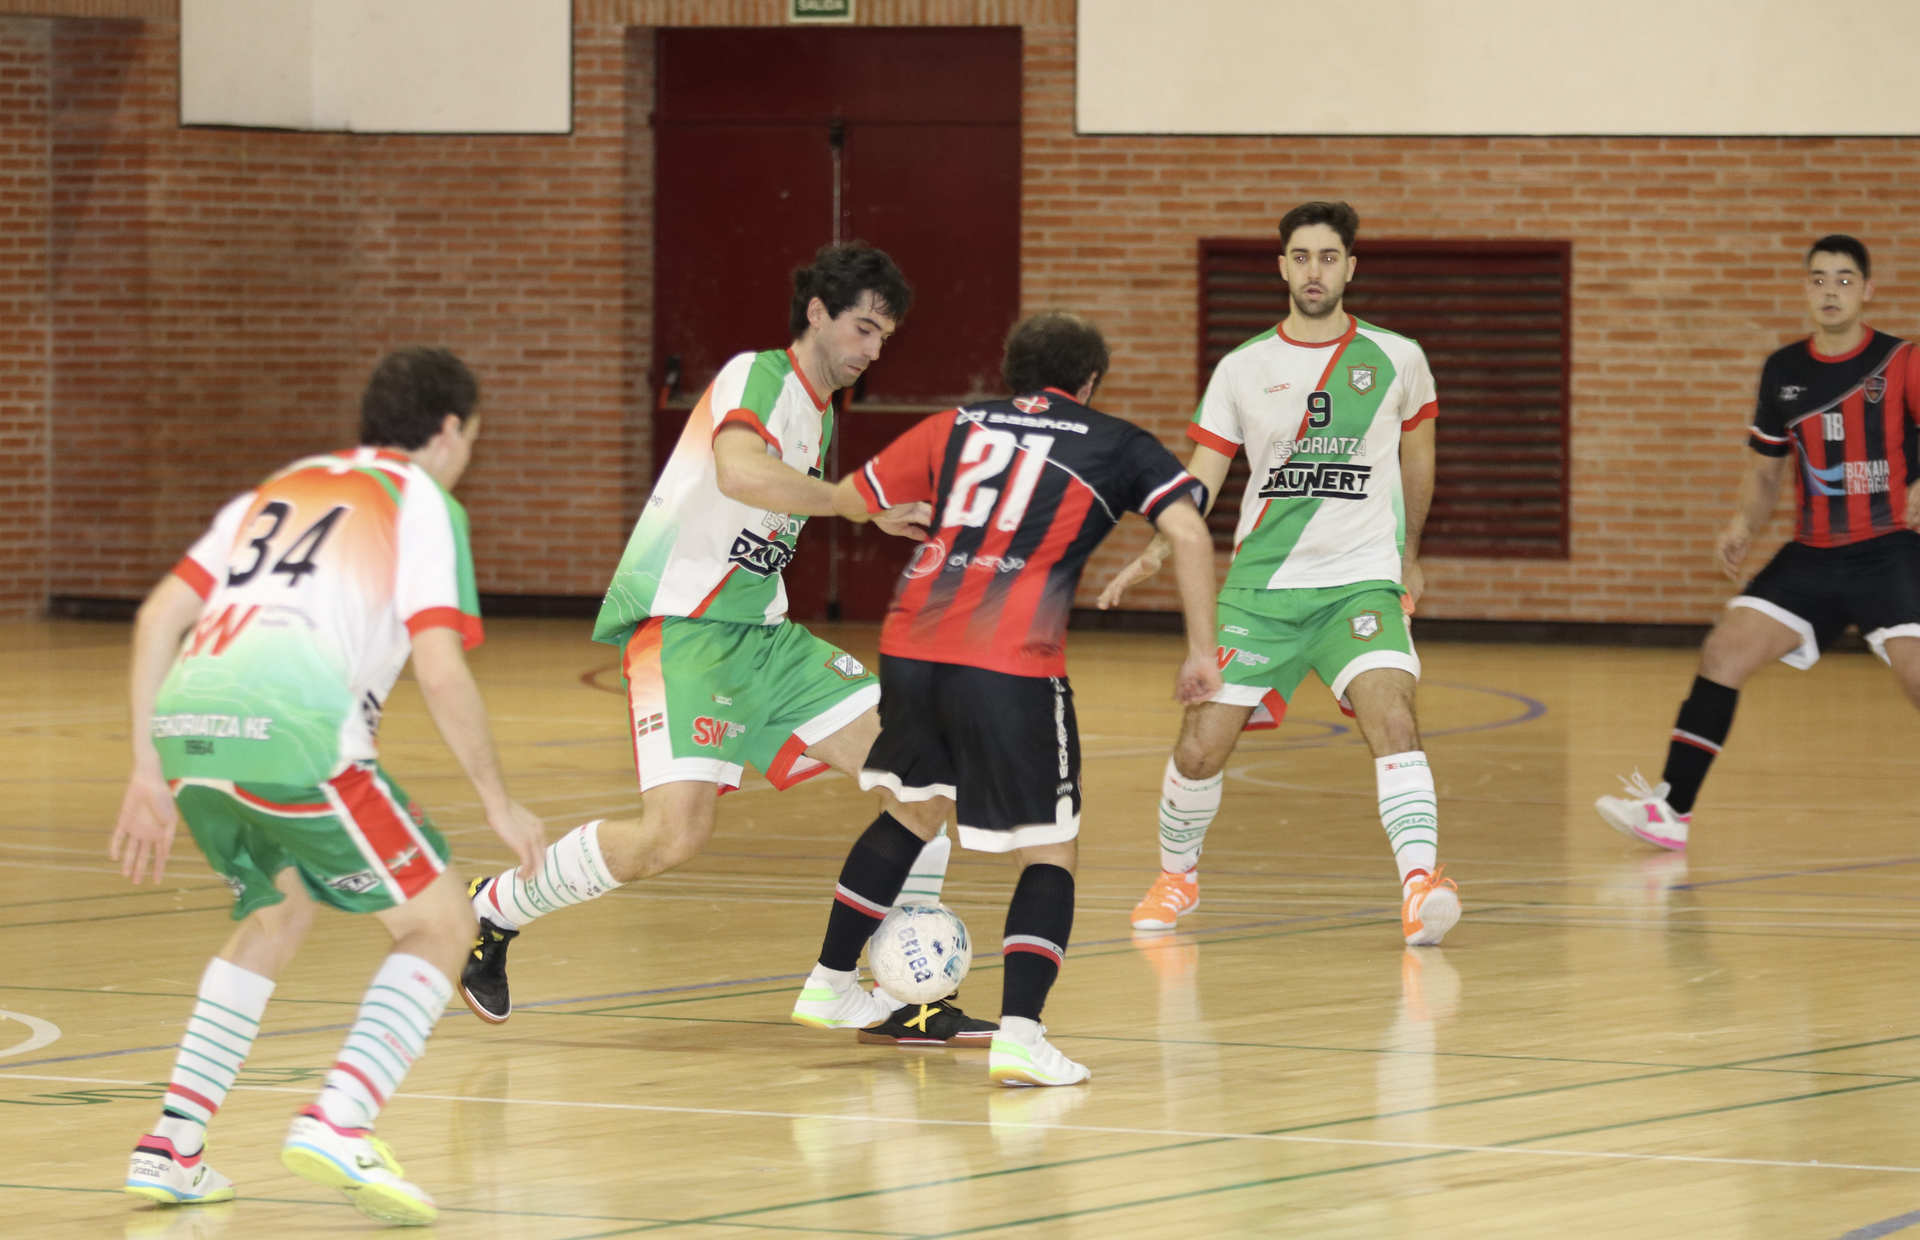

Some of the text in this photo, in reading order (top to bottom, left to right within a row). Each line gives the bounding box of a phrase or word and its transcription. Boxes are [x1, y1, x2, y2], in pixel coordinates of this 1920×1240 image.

[1307, 391, 1332, 428] 9
[1823, 413, 1845, 441] 18
[1273, 436, 1367, 459] ESKORIATZA
[943, 429, 1055, 532] 21
[1846, 460, 1890, 478] BIZKAIA
[228, 501, 346, 587] 34
[691, 715, 730, 749] SW
